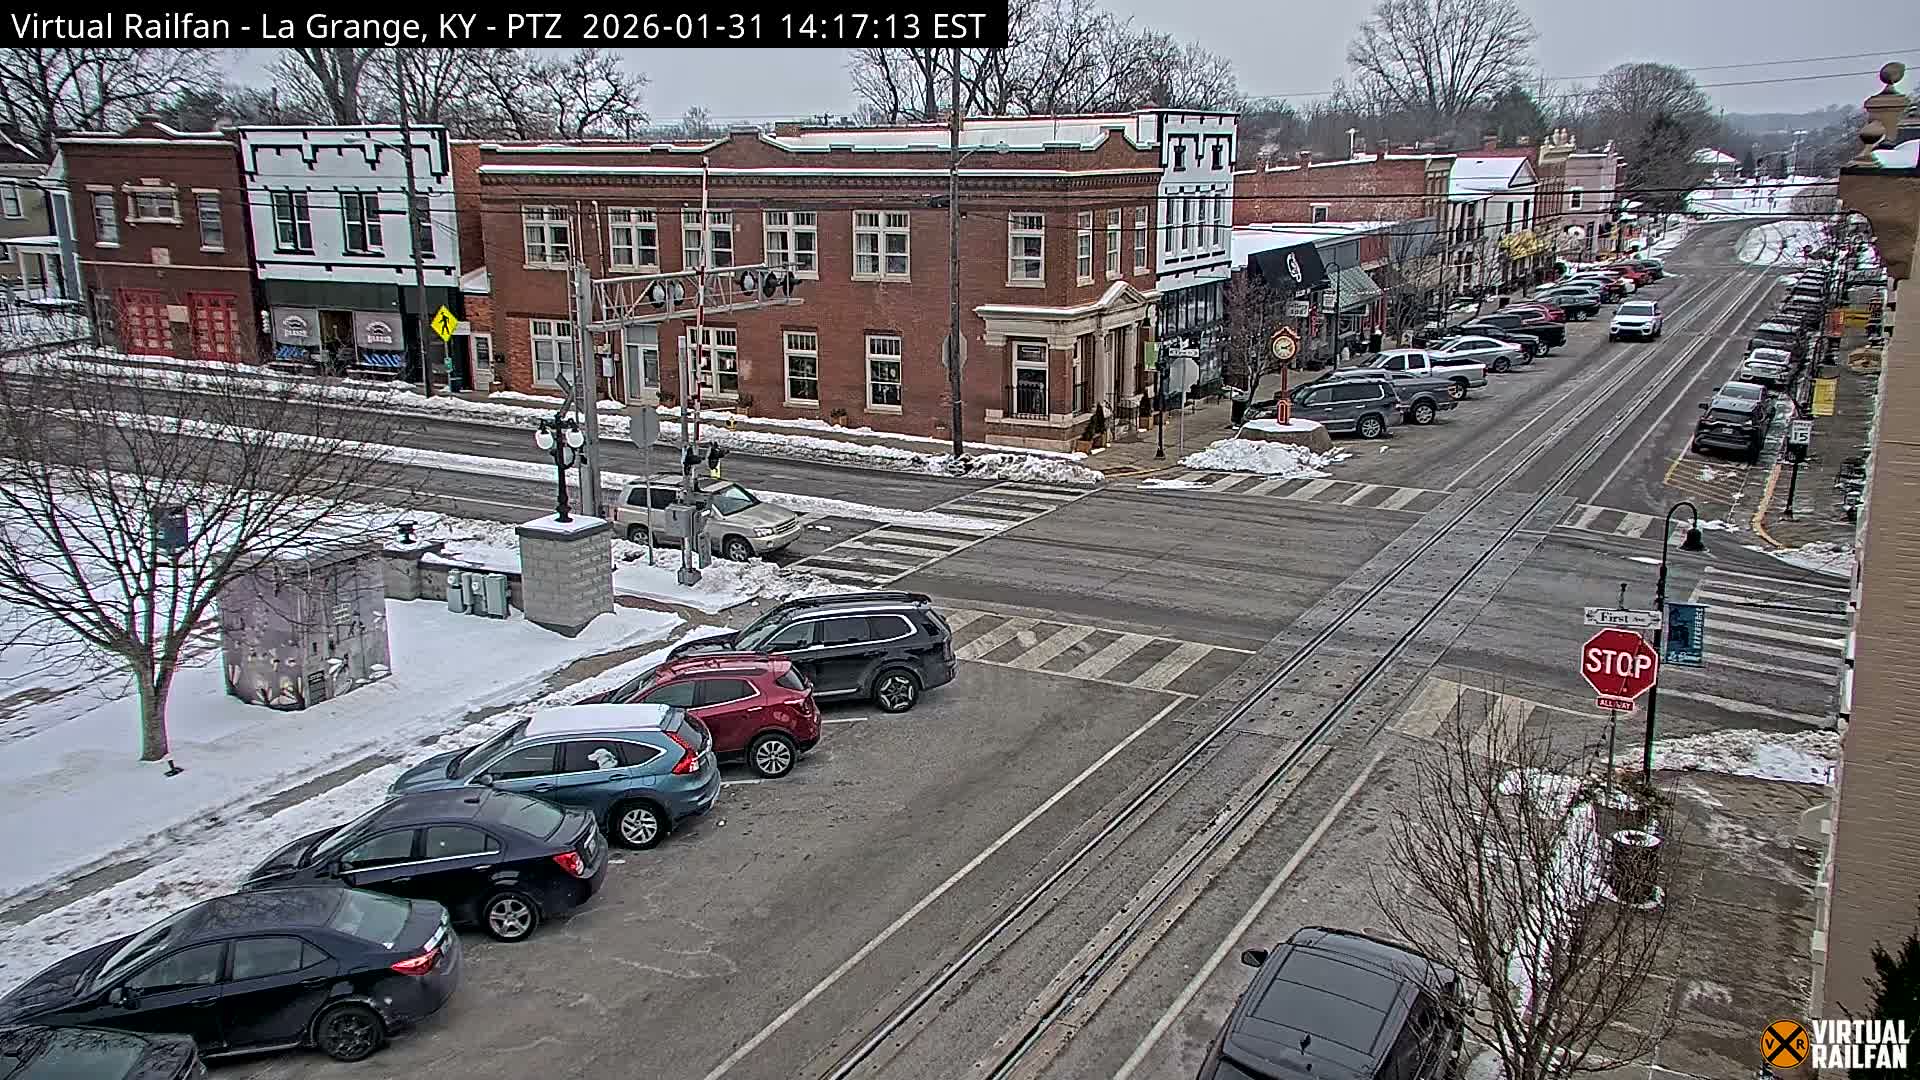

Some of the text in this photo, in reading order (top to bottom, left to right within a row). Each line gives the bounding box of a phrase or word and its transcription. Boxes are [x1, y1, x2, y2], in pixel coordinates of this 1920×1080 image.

[1794, 431, 1808, 441] 15
[1600, 612, 1629, 623] First
[1586, 648, 1651, 678] STOP
[1599, 698, 1631, 710] ALL WAY
